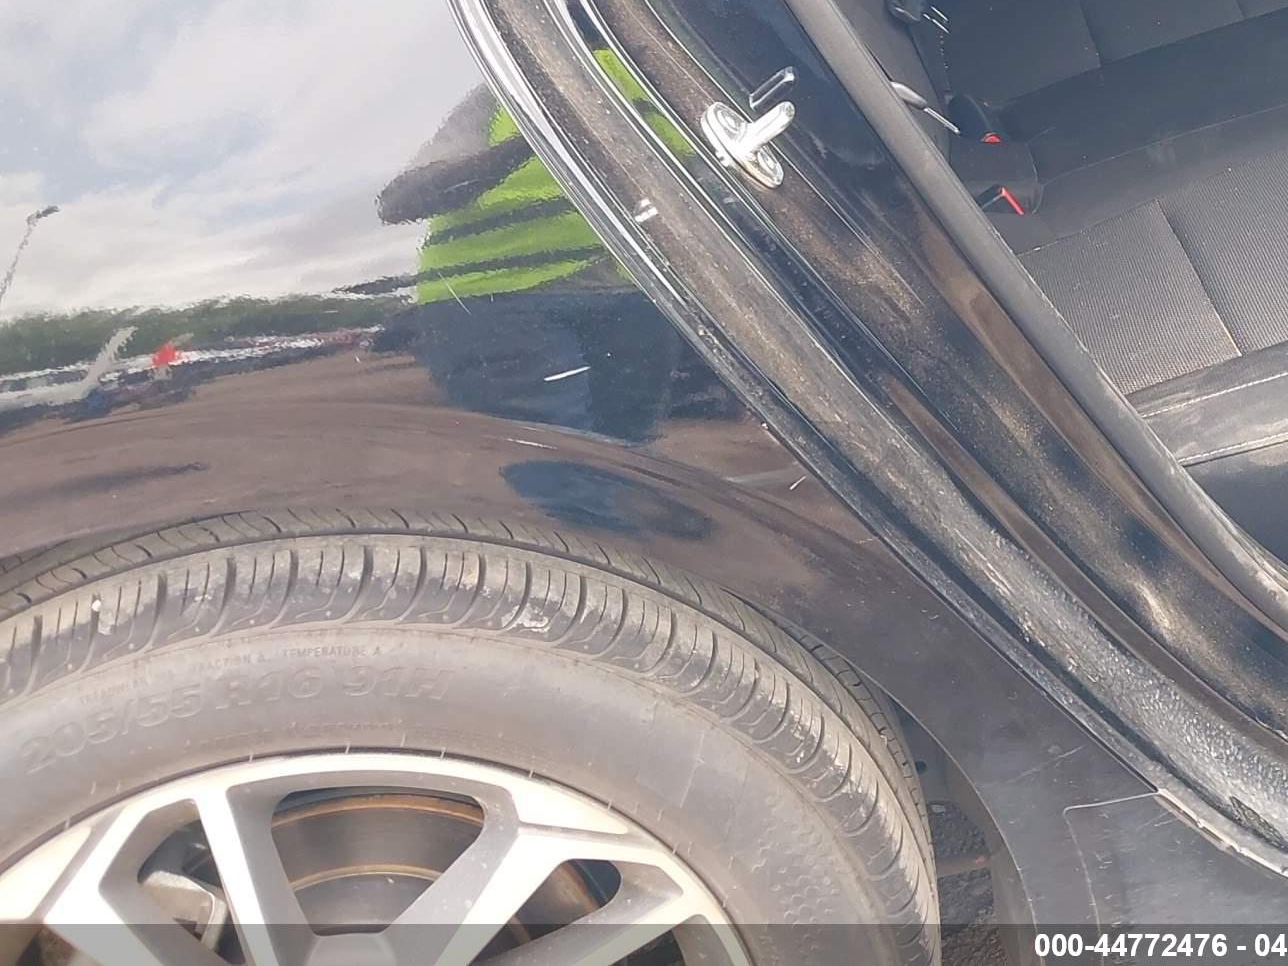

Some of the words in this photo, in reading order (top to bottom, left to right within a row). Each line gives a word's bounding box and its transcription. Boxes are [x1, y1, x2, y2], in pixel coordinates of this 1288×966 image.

[282, 645, 367, 659] TEMPERATURE
[20, 683, 203, 775] 205/55
[214, 665, 323, 711] R16
[341, 663, 456, 702] 91H
